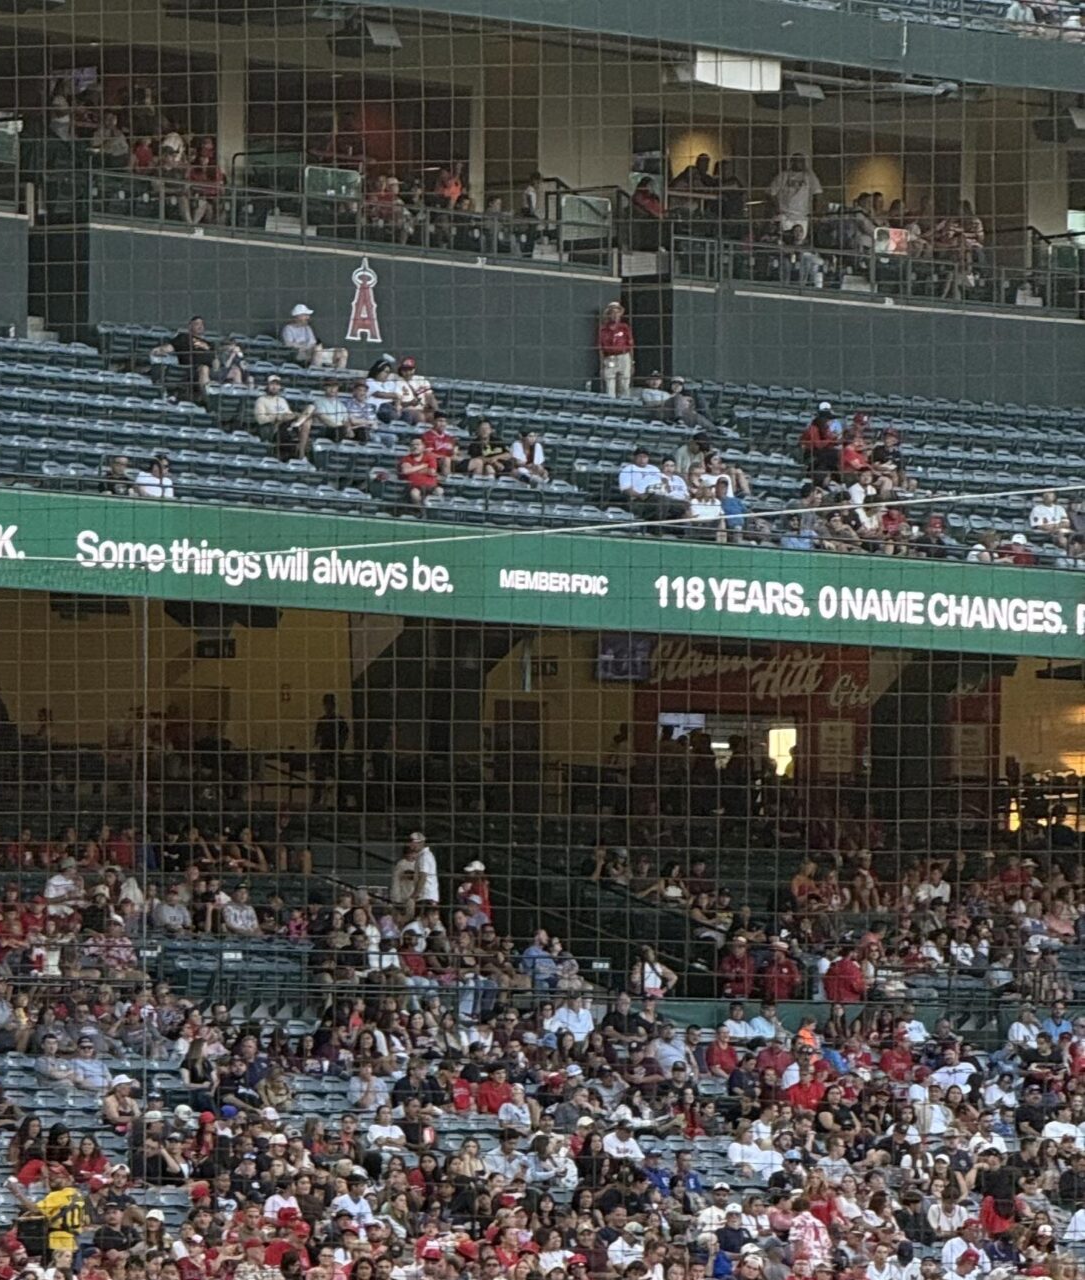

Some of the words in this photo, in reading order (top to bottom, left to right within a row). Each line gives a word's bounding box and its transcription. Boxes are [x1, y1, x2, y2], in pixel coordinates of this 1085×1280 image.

[76, 530, 166, 573] Some
[170, 538, 262, 587] things
[265, 547, 309, 582] will
[312, 550, 408, 597] always
[412, 556, 454, 593] be.
[499, 568, 570, 593] MEMBER
[571, 573, 609, 596] FDIC
[654, 575, 706, 611] 118
[708, 577, 811, 617] YEARS.
[818, 585, 838, 620] 0
[840, 586, 925, 625] NAME
[927, 592, 1068, 635] CHANGES.
